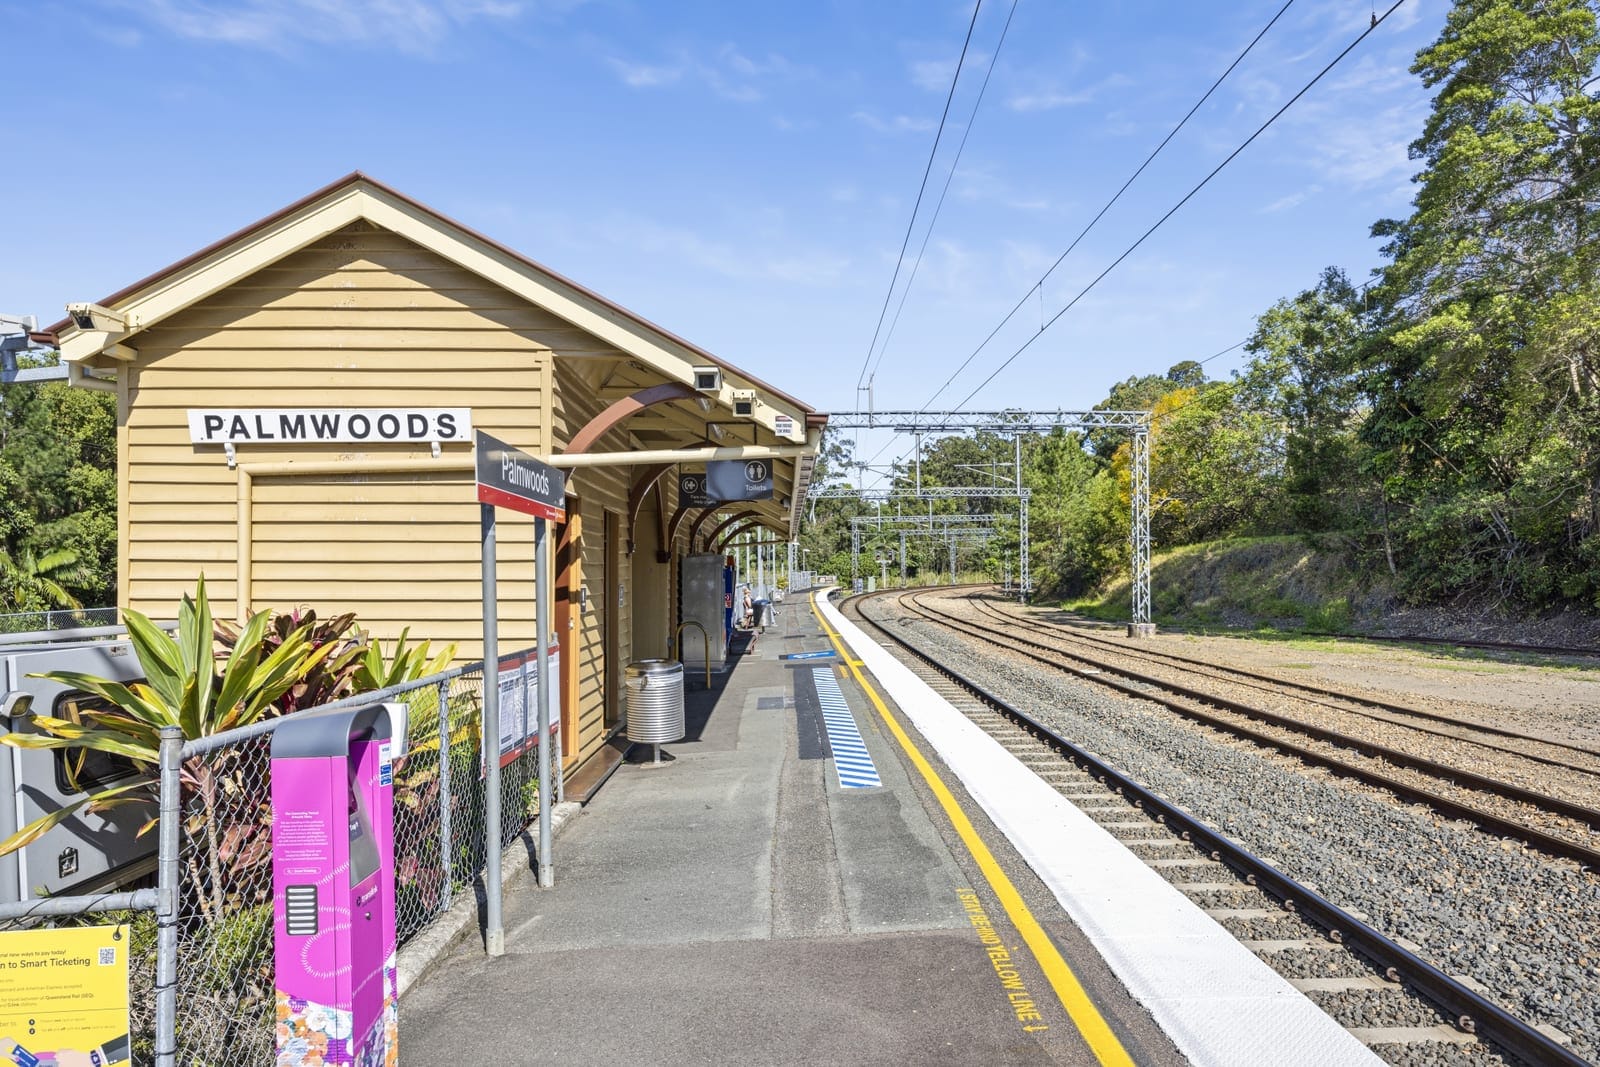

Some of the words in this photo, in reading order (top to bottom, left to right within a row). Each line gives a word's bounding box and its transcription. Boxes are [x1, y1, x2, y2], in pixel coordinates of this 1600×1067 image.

[204, 413, 457, 440] PALMWOODS
[501, 451, 550, 496] Palmwoods
[745, 484, 767, 492] Toilets
[959, 893, 985, 915] STAY
[968, 914, 1001, 945] BEHIND
[20, 959, 47, 968] Smart
[50, 957, 91, 967] Ticketing
[985, 943, 1026, 991] YELLOW
[1008, 991, 1042, 1022] LINE
